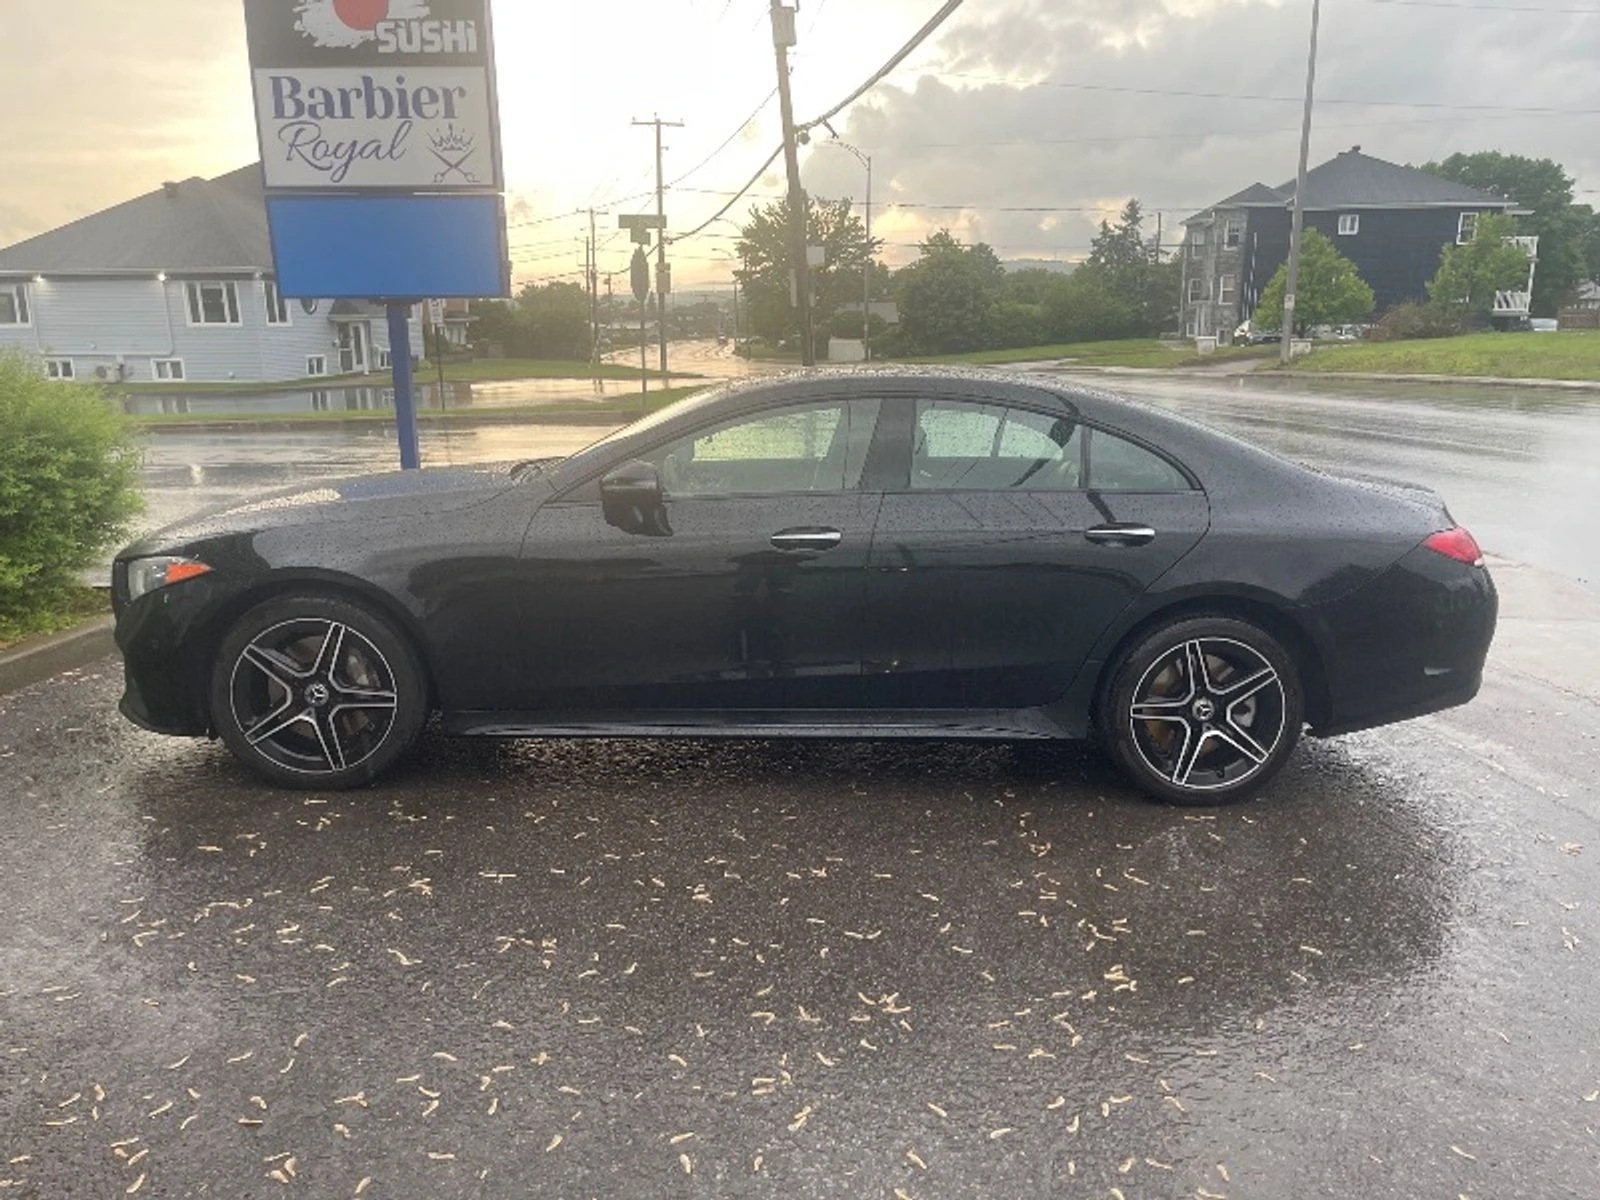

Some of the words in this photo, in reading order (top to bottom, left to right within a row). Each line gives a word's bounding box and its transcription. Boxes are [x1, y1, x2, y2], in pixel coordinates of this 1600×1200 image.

[376, 20, 477, 53] SUSHI
[269, 75, 466, 119] Barbier
[278, 121, 412, 182] Royal
